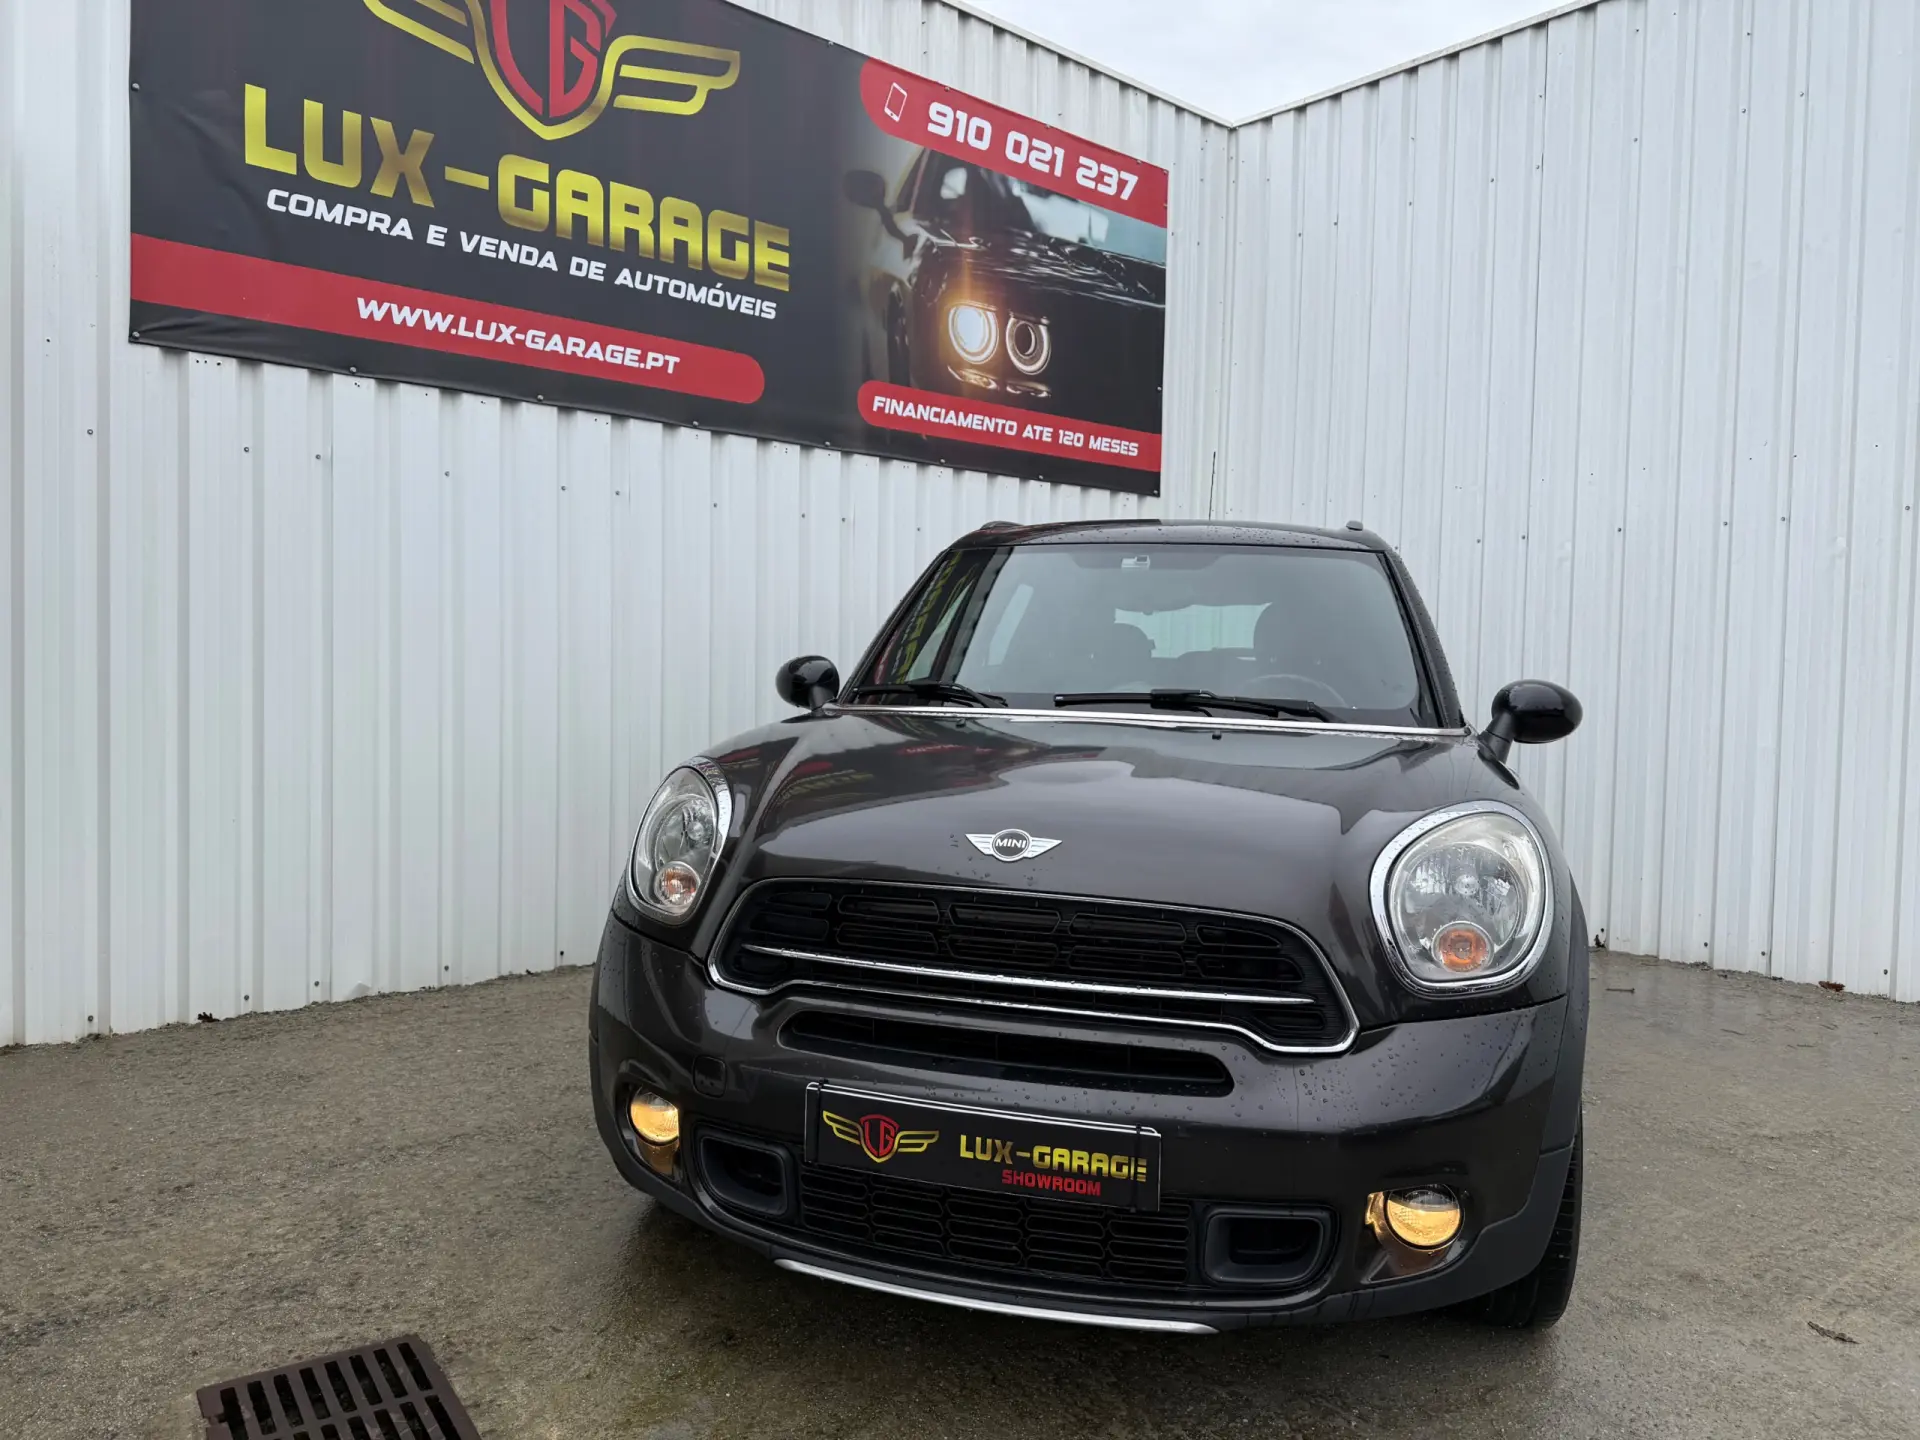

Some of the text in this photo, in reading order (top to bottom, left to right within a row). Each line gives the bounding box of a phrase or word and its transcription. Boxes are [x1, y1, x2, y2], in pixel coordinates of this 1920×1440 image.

[927, 101, 1139, 201] 910 021 237
[245, 83, 790, 292] LUX-GARAGE
[266, 188, 777, 320] COMPRA E VENDA DE AUTOMÓVEIS
[356, 297, 681, 375] WWW.LUX-GARAGE.PT
[872, 396, 1139, 457] FINANCIAMENTO ATE 120 MESES
[995, 838, 1027, 849] MINI
[960, 1134, 1147, 1183] LUX-GARAGE
[1002, 1169, 1101, 1197] SHOWROOM
